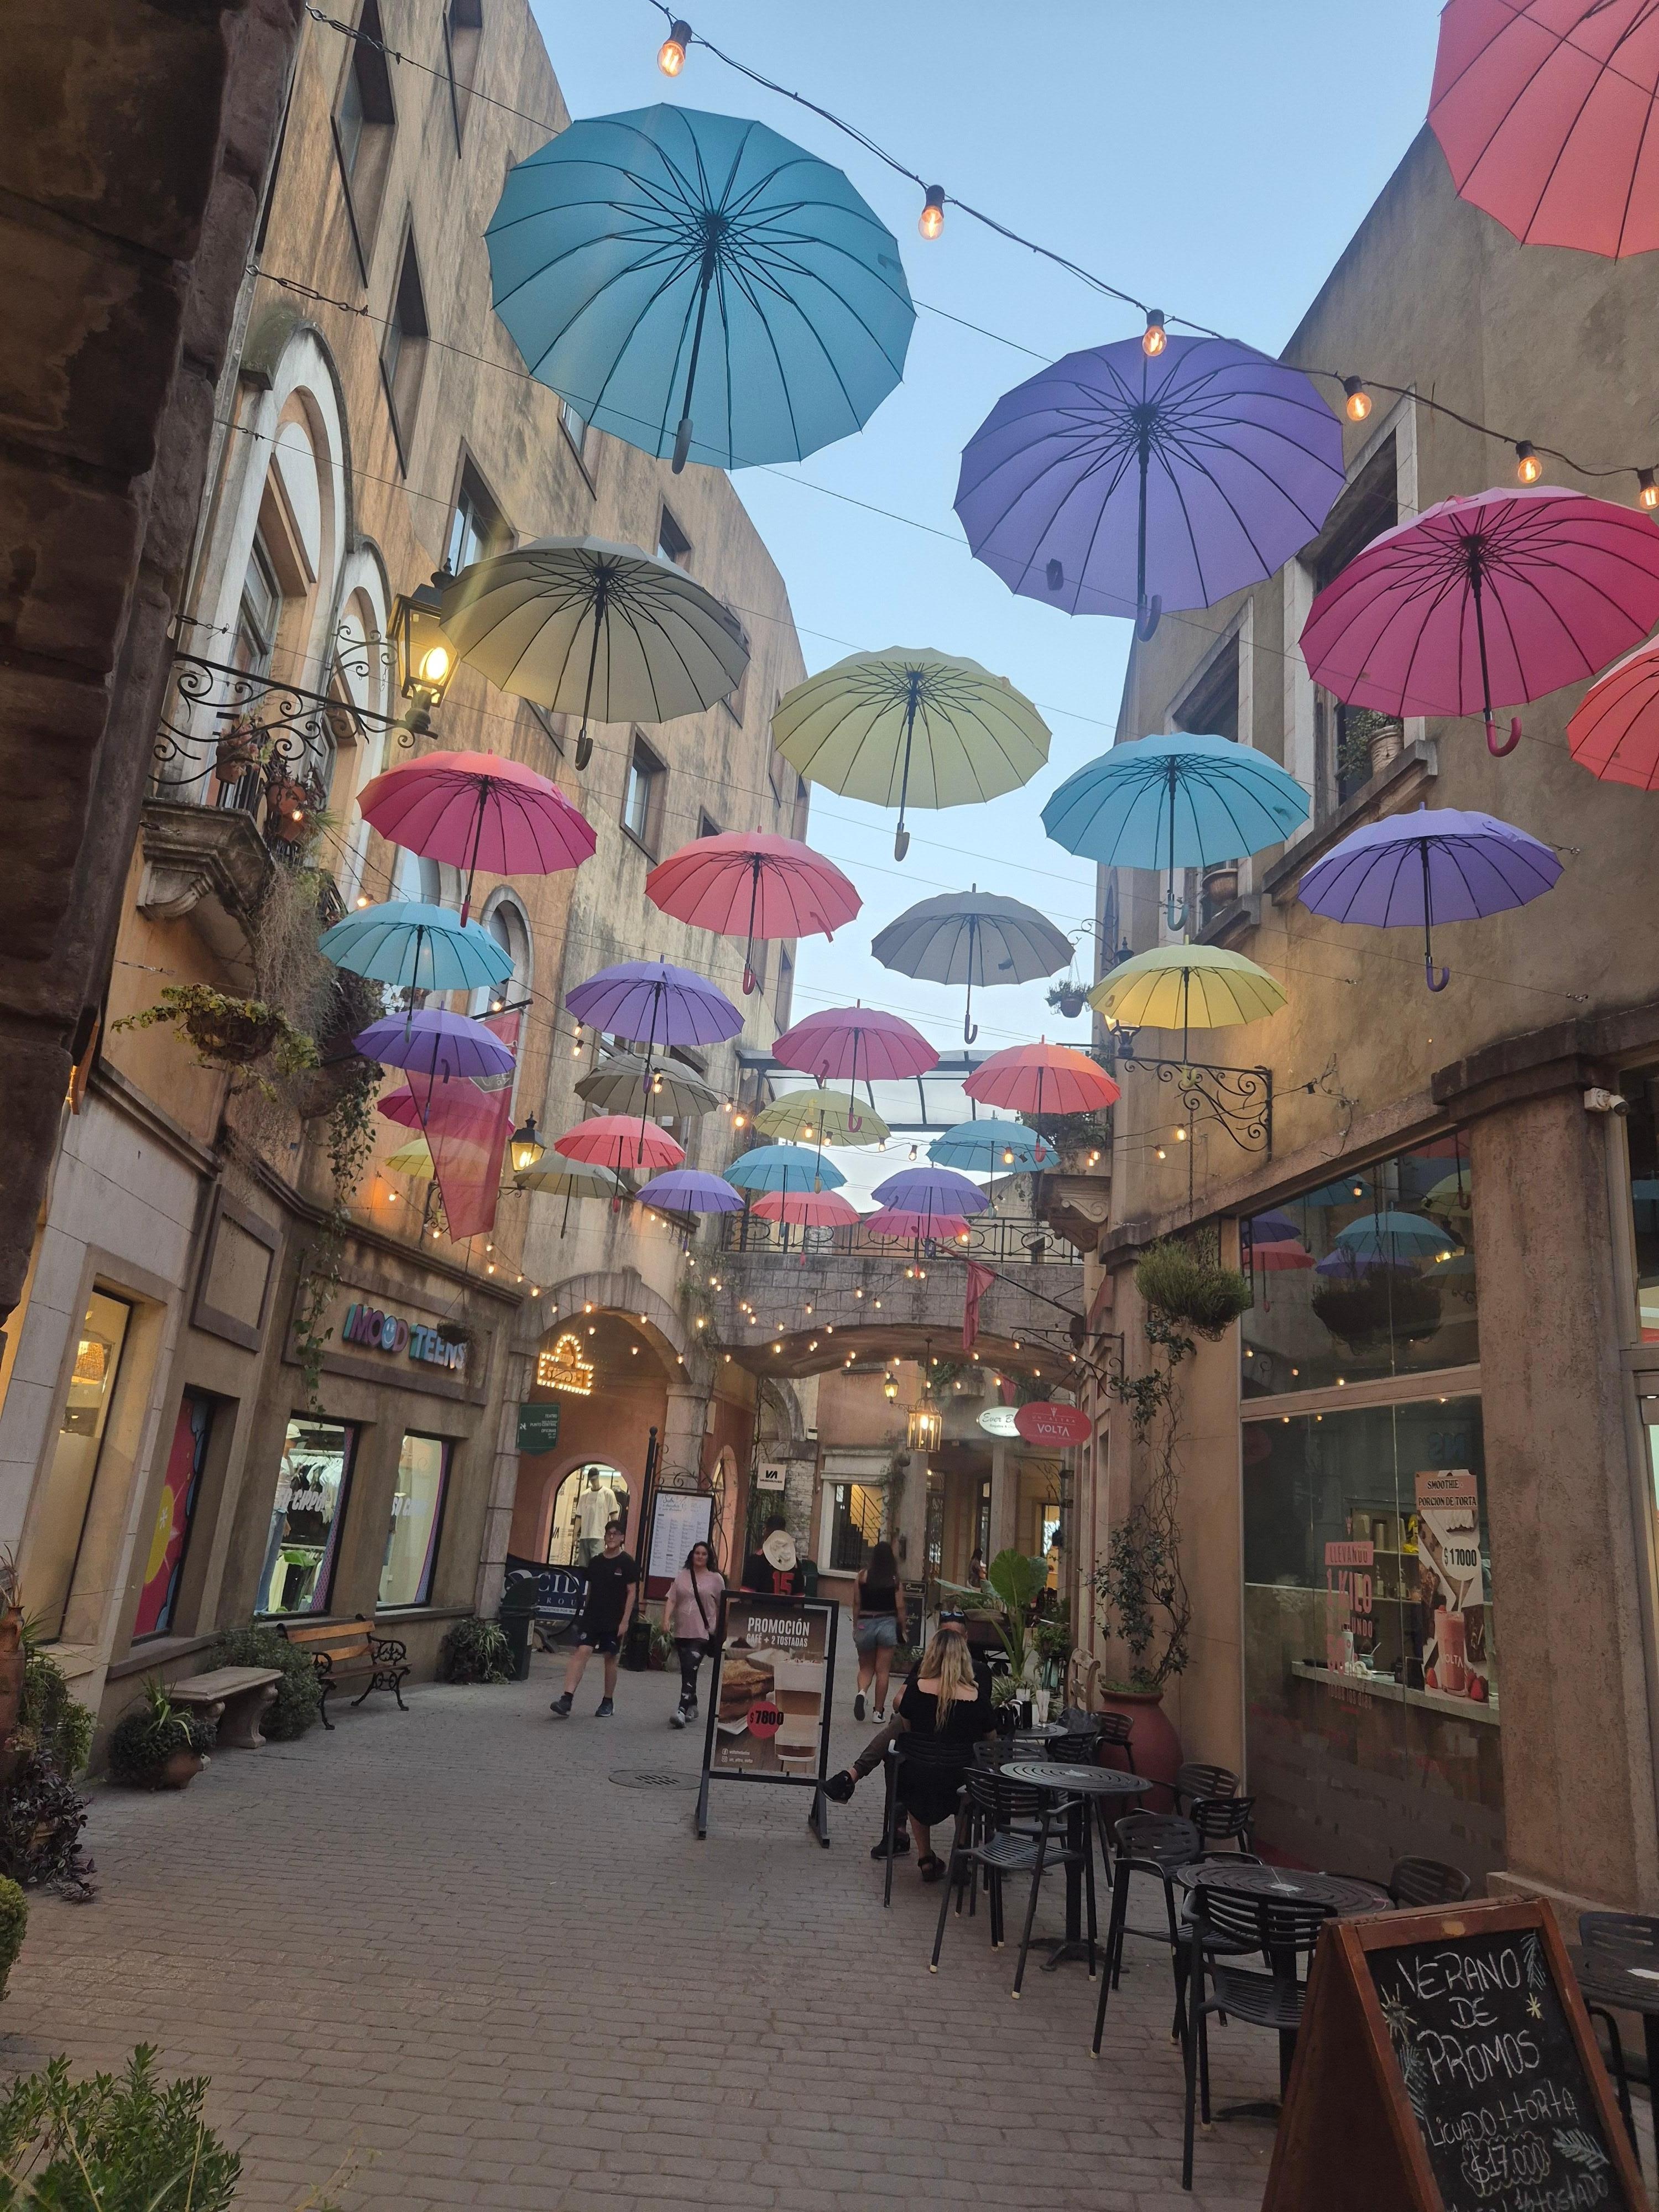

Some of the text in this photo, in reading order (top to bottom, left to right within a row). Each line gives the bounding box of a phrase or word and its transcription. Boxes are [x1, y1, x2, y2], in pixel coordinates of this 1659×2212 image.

[343, 1303, 409, 1353] MOOD
[982, 1412, 1001, 1422] Ever
[1037, 1423, 1070, 1437] VOLTA
[1427, 1479, 1459, 1490] SMOOTHIE
[1446, 1496, 1454, 1506] DE
[1455, 1496, 1477, 1506] TORTA
[1338, 1569, 1373, 1614] KILO
[748, 1617, 810, 1636] PROMOCIÓN
[746, 1632, 763, 1644] CAFÉ
[771, 1635, 776, 1645] 2
[777, 1636, 808, 1647] TOSTADAS
[1396, 1948, 1521, 2000] VERANO
[1449, 1996, 1498, 2029] DE
[1416, 2030, 1540, 2089] PROMOS
